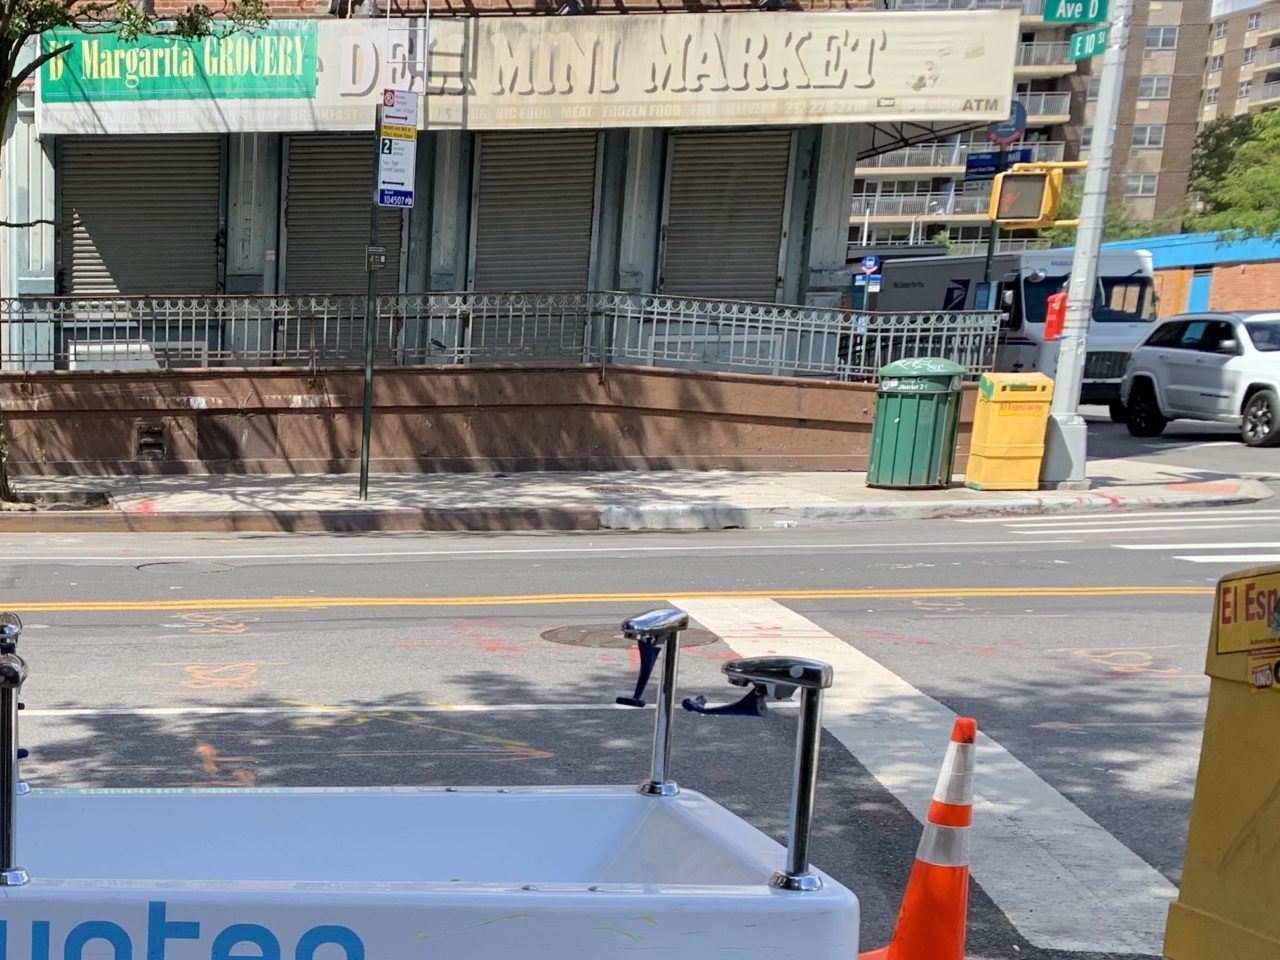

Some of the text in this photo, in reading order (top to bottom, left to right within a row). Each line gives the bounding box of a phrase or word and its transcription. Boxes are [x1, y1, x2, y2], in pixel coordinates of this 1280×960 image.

[1056, 0, 1099, 18] Ave D
[1075, 36, 1083, 56] E
[1084, 33, 1096, 54] 10
[81, 37, 195, 88] Margarita
[203, 35, 308, 78] GROCERY
[490, 32, 622, 96] MINI
[644, 28, 888, 95] MARKET
[561, 105, 593, 119] MEAT
[602, 104, 647, 118] FROZEN
[649, 103, 682, 118] FOOD
[962, 98, 998, 112] ATM
[1221, 586, 1238, 625] El
